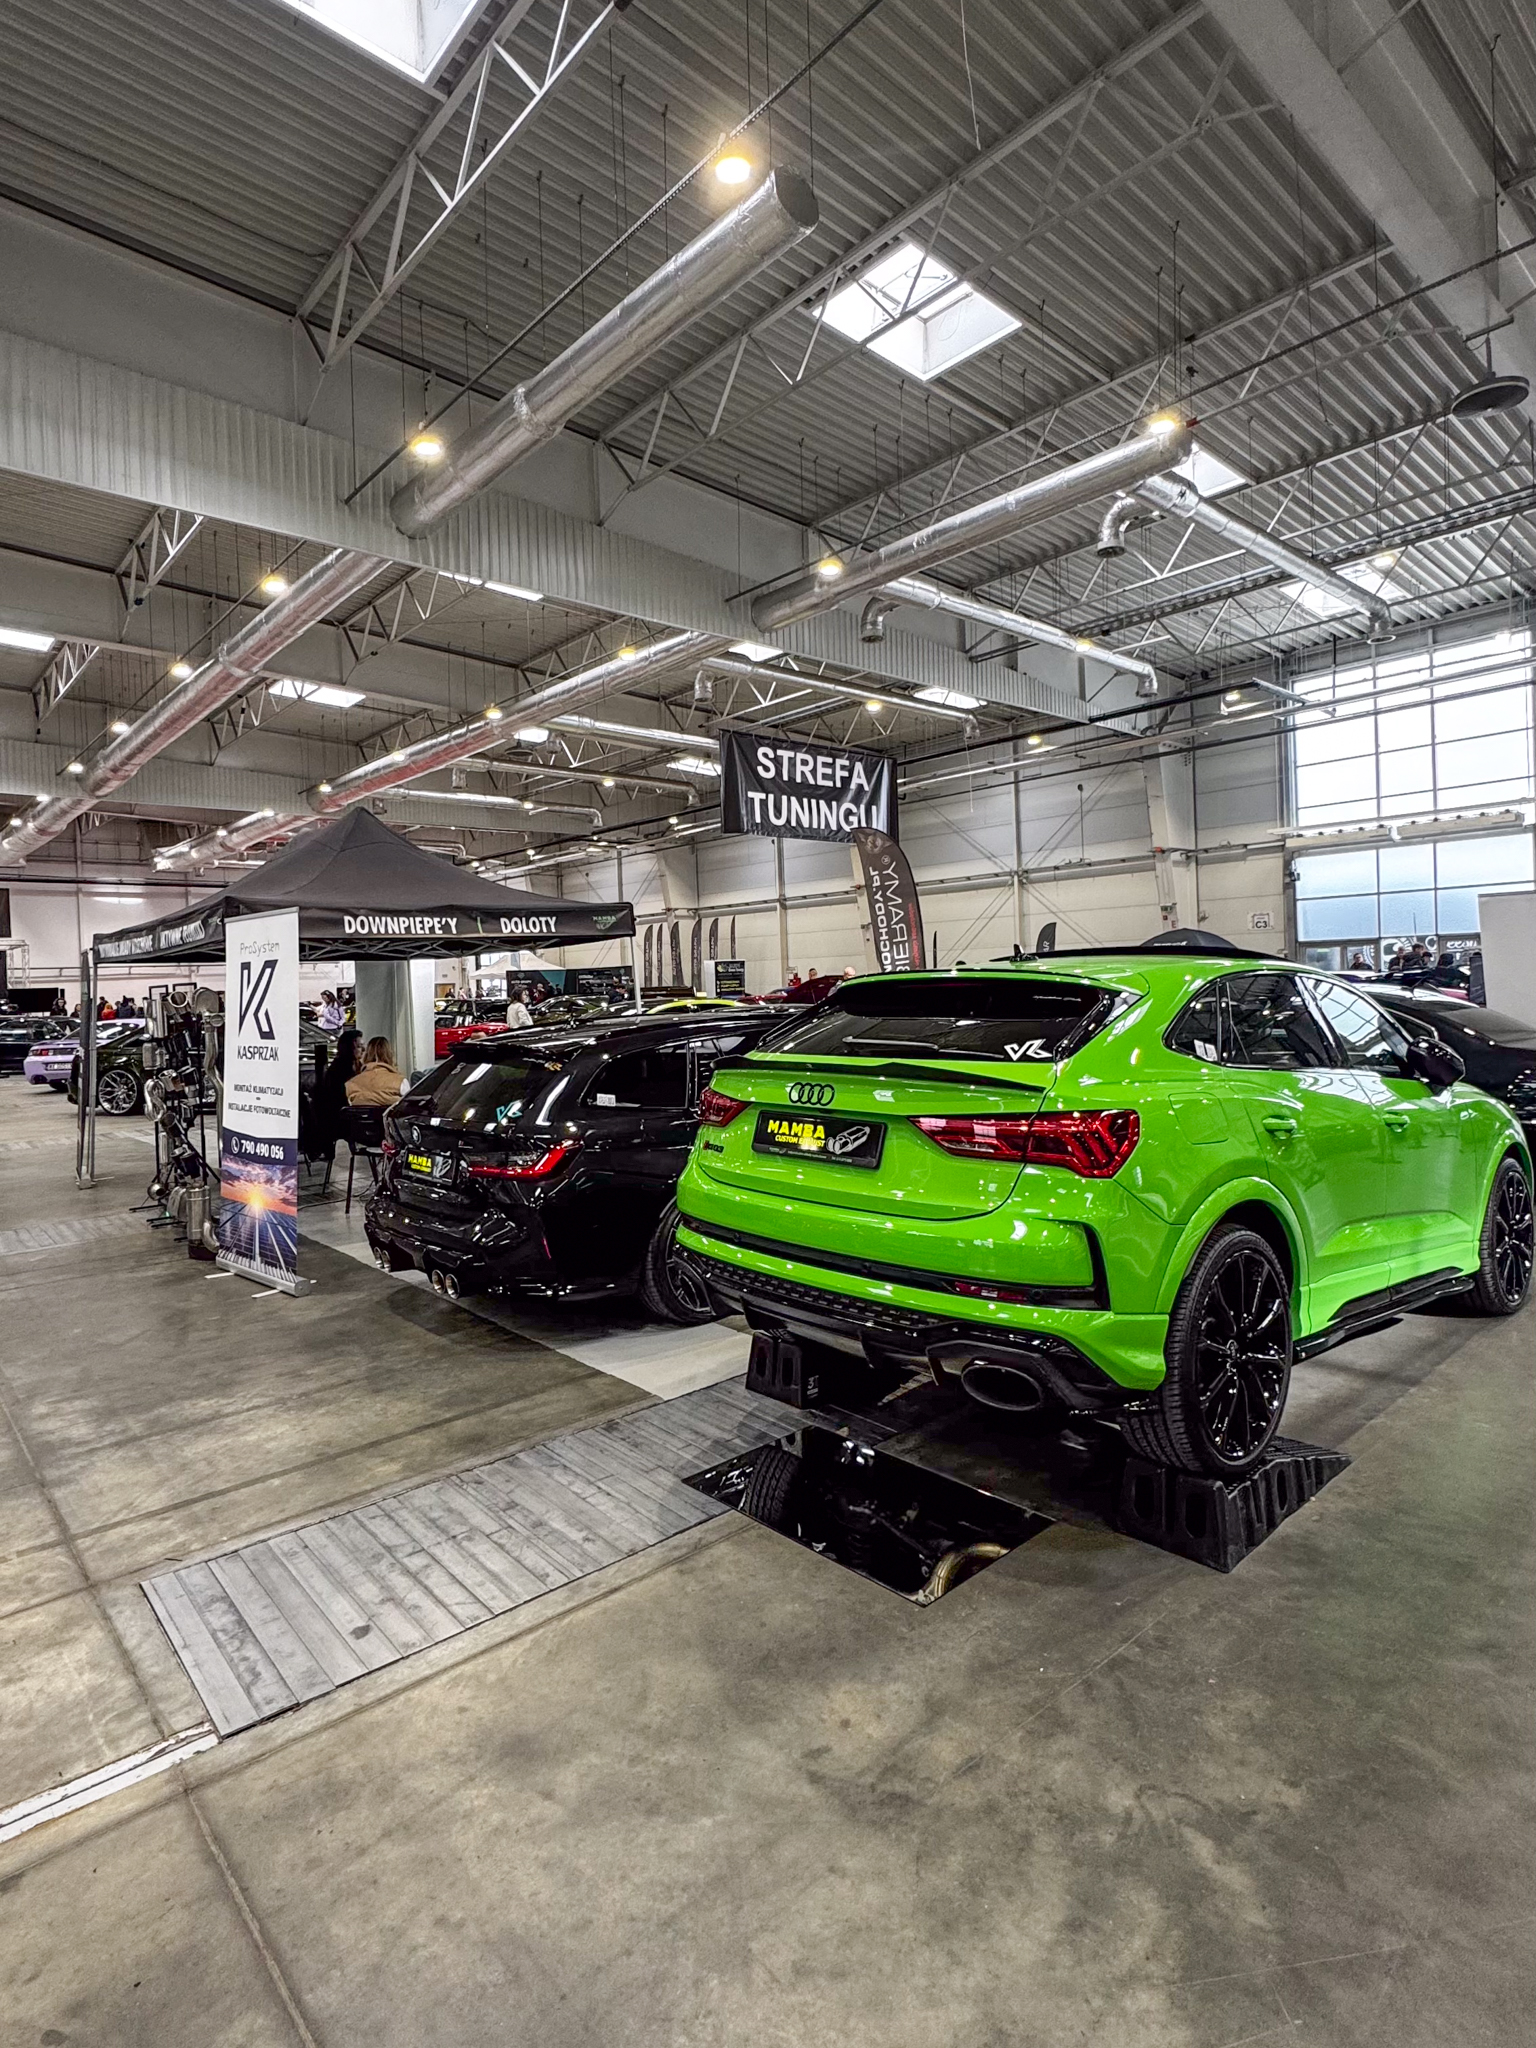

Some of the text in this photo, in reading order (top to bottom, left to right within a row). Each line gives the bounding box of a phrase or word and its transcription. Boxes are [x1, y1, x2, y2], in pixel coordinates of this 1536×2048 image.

[757, 747, 869, 791] STREFA
[747, 791, 877, 832] TUNINGU
[343, 915, 557, 934] DOWNPIEPE'Y DOLOTY
[1255, 920, 1268, 929] C3
[240, 940, 280, 957] ProSystem
[237, 1045, 279, 1061] KASPRZAK
[767, 1119, 825, 1139] MAMBA
[775, 1134, 798, 1144] CUSTOM
[241, 1140, 284, 1160] 790 490 056
[408, 1153, 432, 1168] MAMBA
